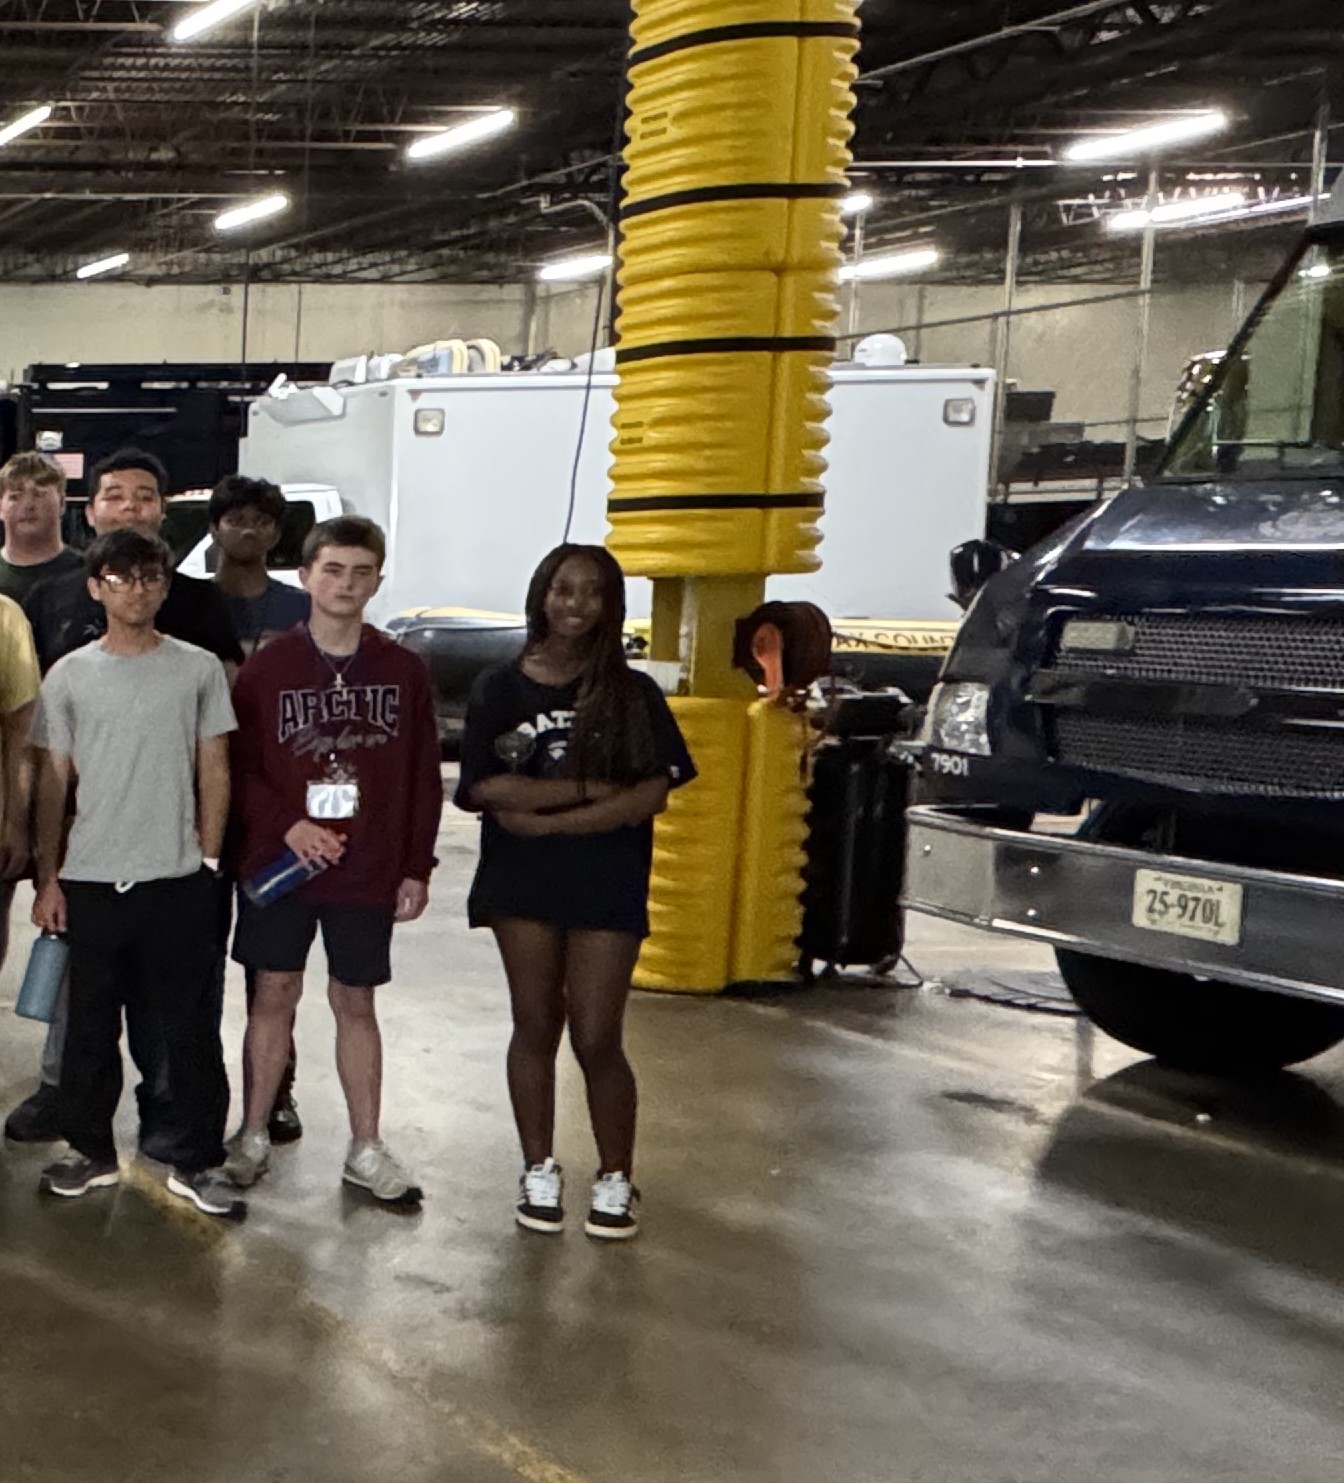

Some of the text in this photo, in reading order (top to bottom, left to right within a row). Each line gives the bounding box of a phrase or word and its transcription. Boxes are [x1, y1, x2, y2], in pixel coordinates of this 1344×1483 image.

[278, 685, 400, 743] ARCTIC
[930, 752, 970, 776] 7901
[1145, 888, 1227, 928] 25-970L
